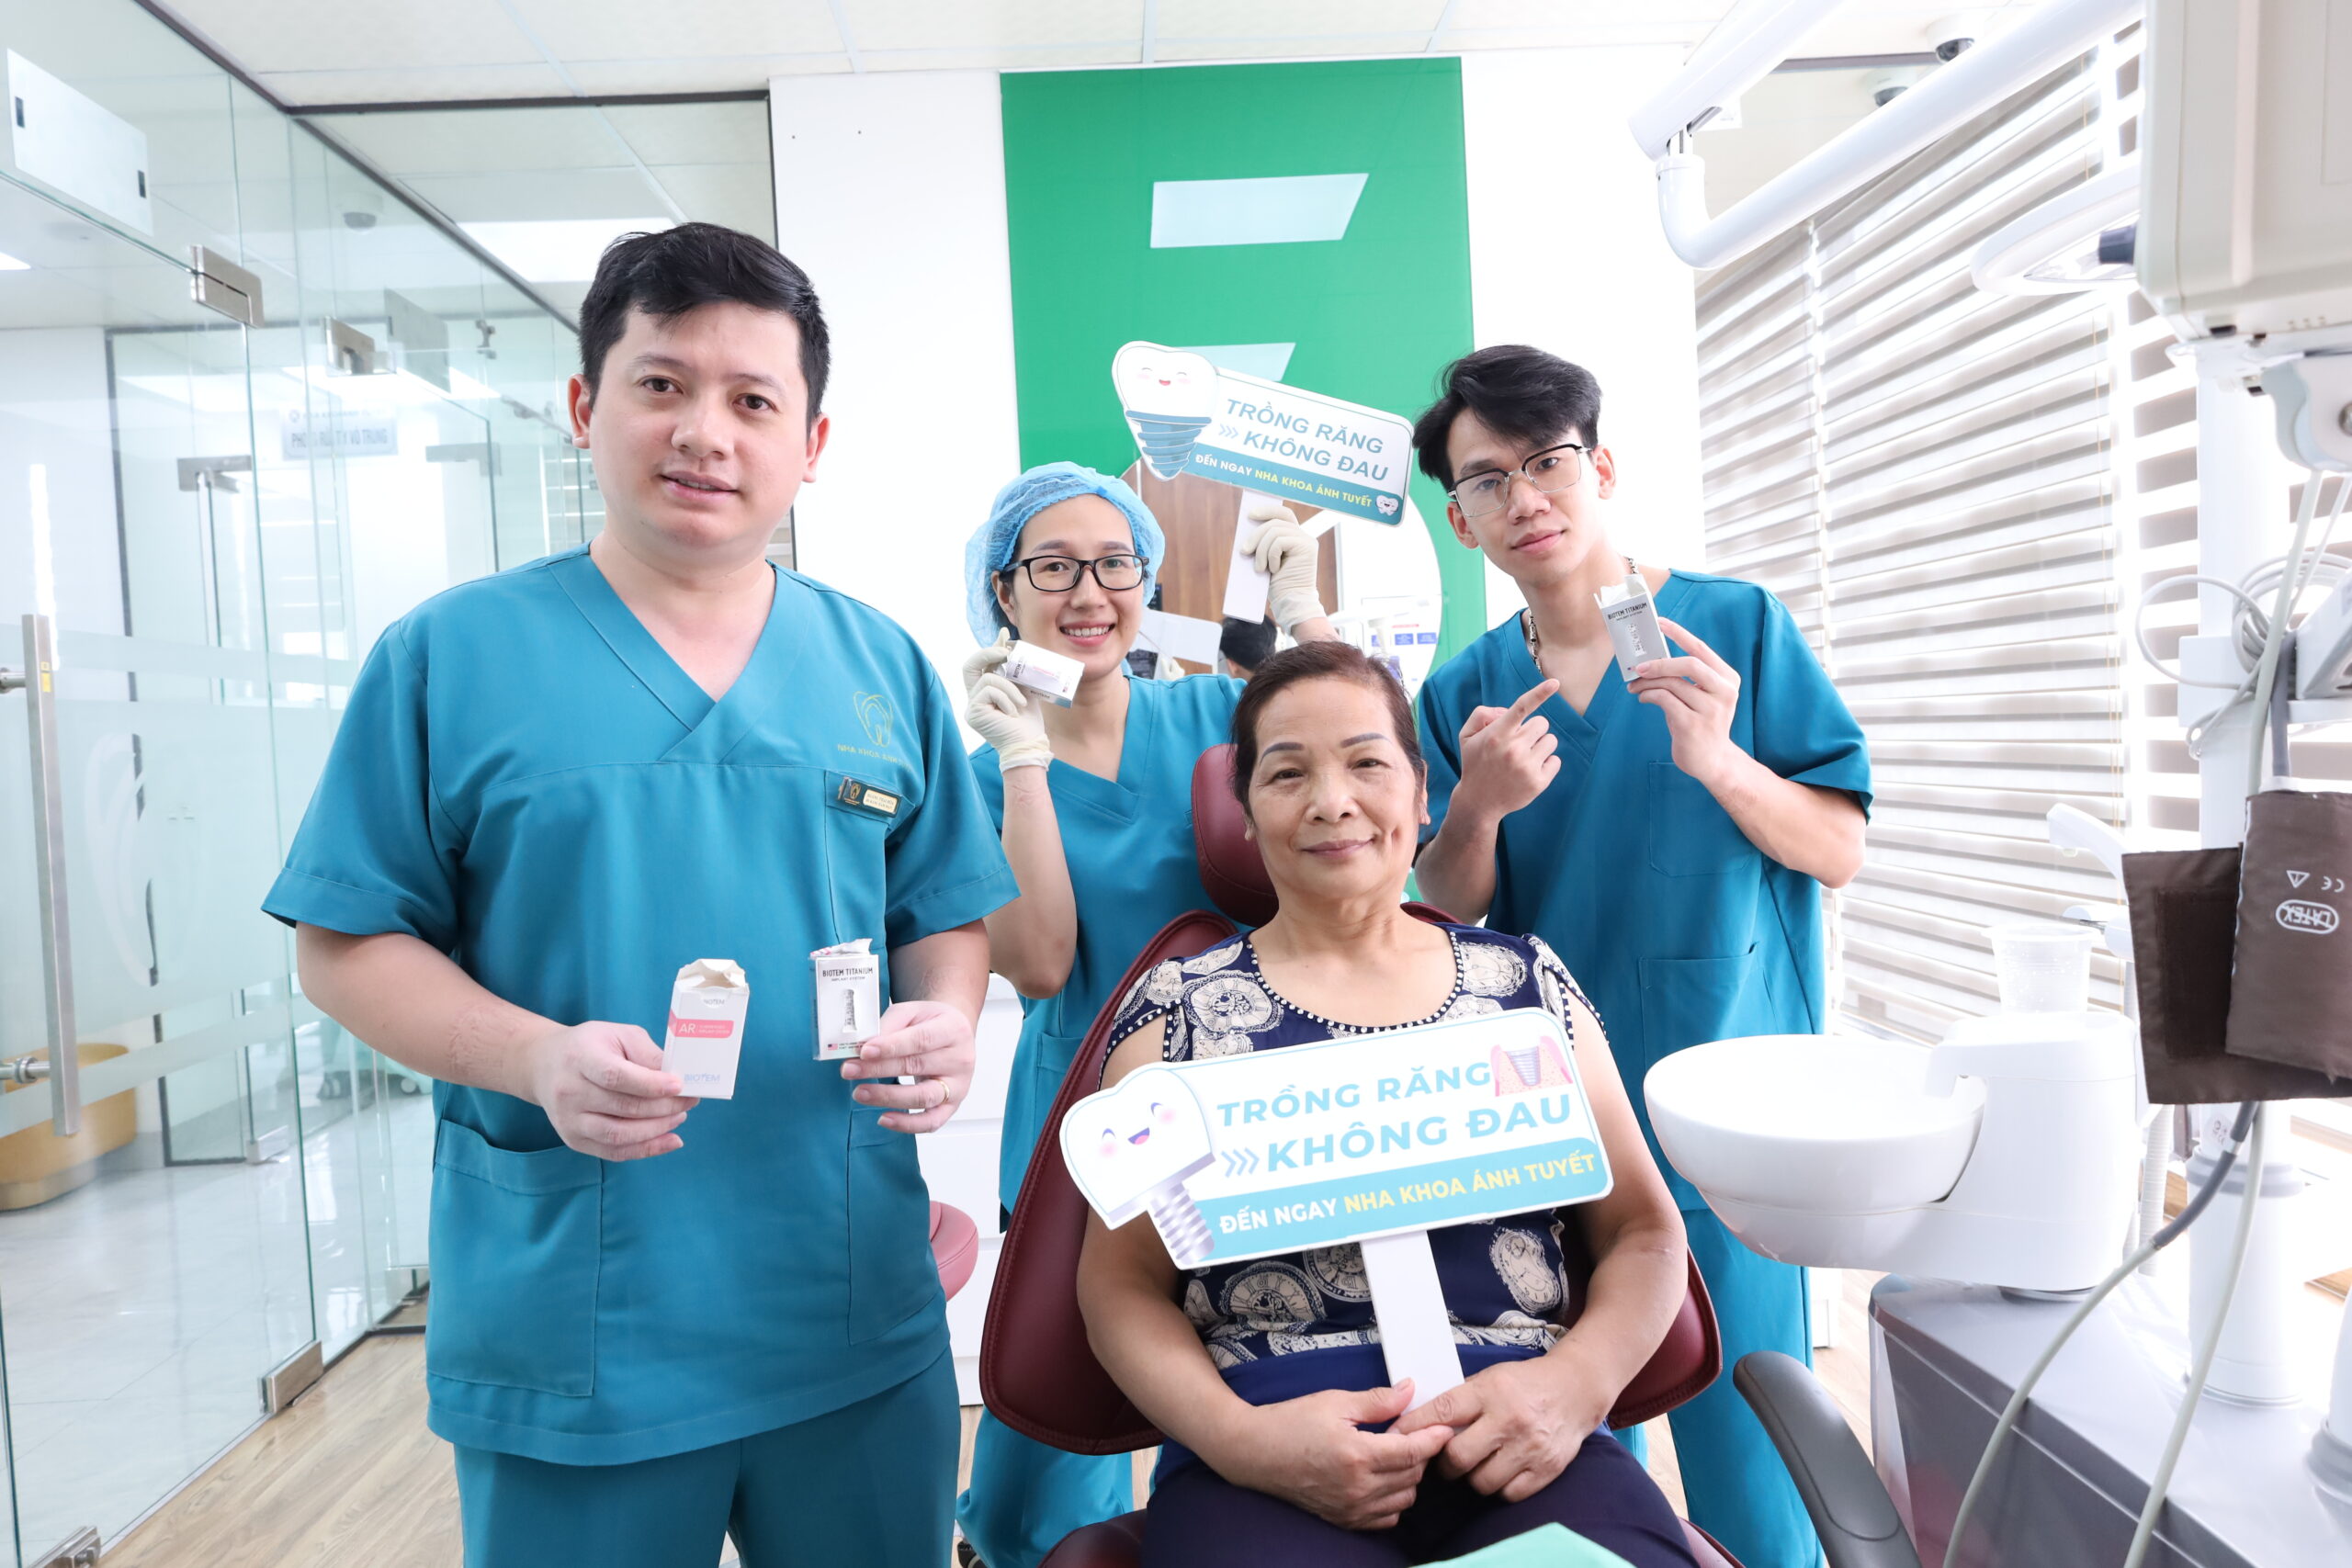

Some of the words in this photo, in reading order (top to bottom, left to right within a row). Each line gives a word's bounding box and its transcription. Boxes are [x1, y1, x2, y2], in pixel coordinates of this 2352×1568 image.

[1227, 399, 1309, 434] TRỒNG
[1315, 423, 1384, 454] RĂNG
[1195, 452, 1217, 468] ĐẾN
[1220, 458, 1252, 476] NGAY
[1255, 469, 1279, 484] NHA
[1282, 477, 1313, 492] KHOA
[1316, 482, 1340, 499] ÁNH
[1342, 491, 1373, 508] TUYẾT
[1243, 430, 1331, 466] KHÔNG
[1337, 456, 1388, 481] ĐAU
[1608, 610, 1624, 619] BIOTEM
[1625, 603, 1646, 614] TITANIUM
[2284, 904, 2331, 928] LATEX
[822, 969, 844, 977] BIOTEM
[845, 967, 873, 976] TITANIUM
[679, 1023, 696, 1033] AR
[684, 1073, 720, 1083] BIOTEM
[1217, 1083, 1362, 1127] TRỒNG
[1378, 1061, 1491, 1102] RĂNG
[1268, 1115, 1447, 1172] KHÔNG
[1466, 1094, 1572, 1138] ĐAU
[1219, 1203, 1270, 1235] ĐẾN
[1274, 1199, 1338, 1226] NGAY
[1344, 1189, 1395, 1215] NHA
[1399, 1176, 1467, 1205] KHOA
[1472, 1165, 1521, 1193] ÁNH
[1524, 1150, 1596, 1183] TUYẾT
